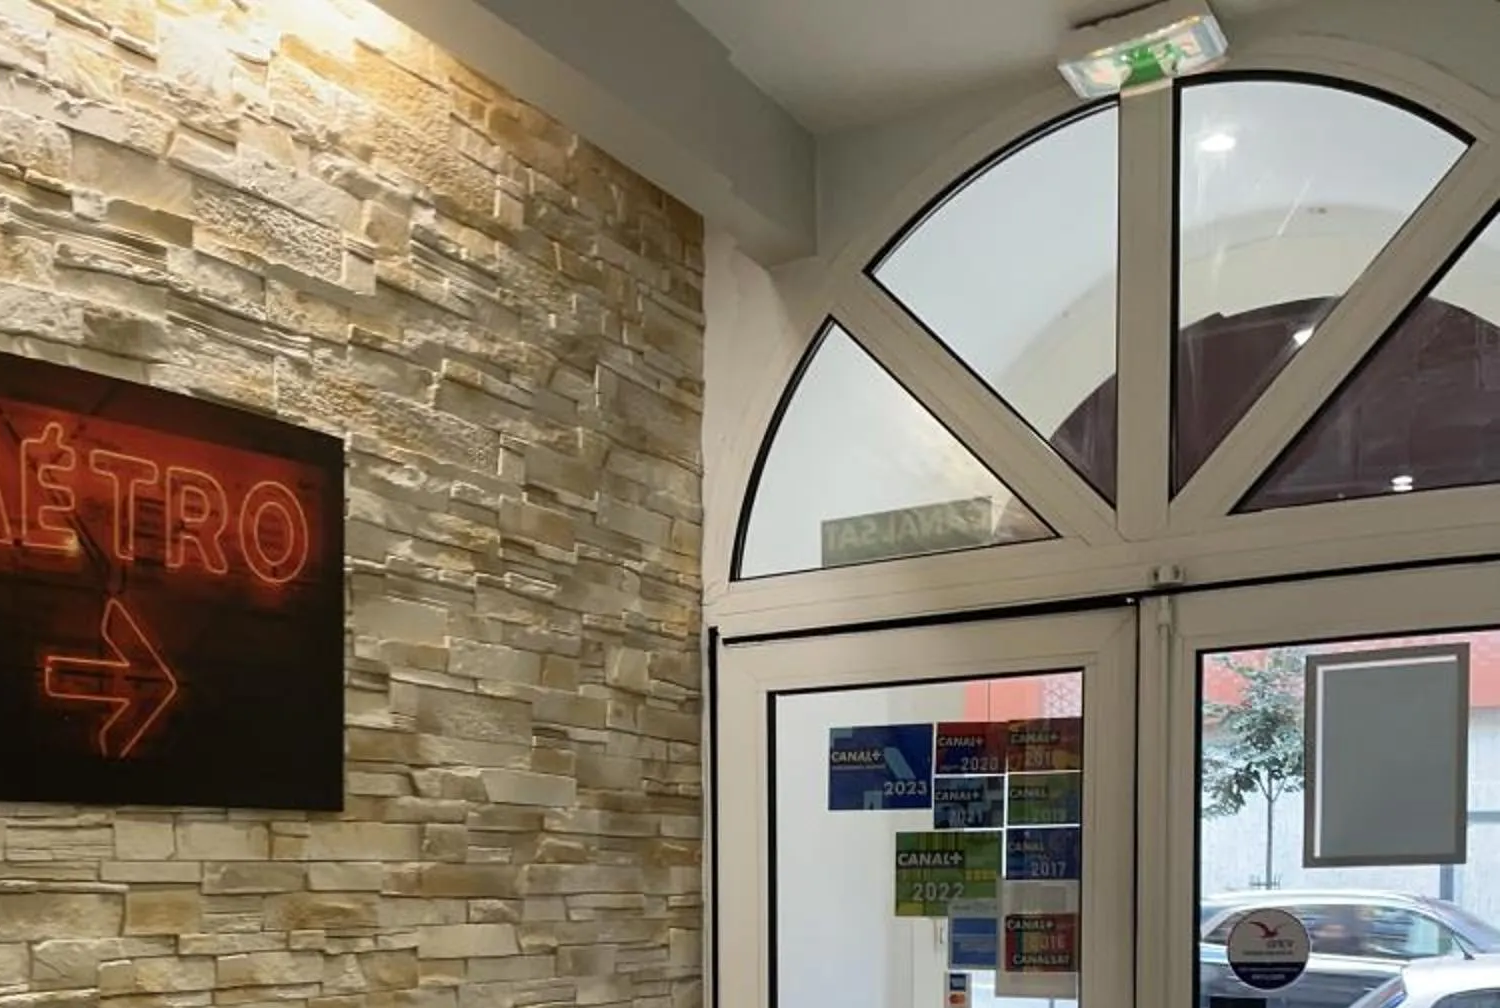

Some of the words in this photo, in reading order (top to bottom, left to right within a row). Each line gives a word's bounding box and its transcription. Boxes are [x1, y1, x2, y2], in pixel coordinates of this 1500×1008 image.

[938, 735, 984, 747] CANAL+
[831, 749, 883, 763] CANAL+
[960, 756, 999, 771] 2020
[883, 780, 928, 796] 2023
[935, 789, 980, 801] CANAL+
[897, 851, 964, 868] CANAL+
[1030, 861, 1067, 877] 2017
[912, 882, 966, 901] 2022
[1007, 918, 1054, 930] CANAL+
